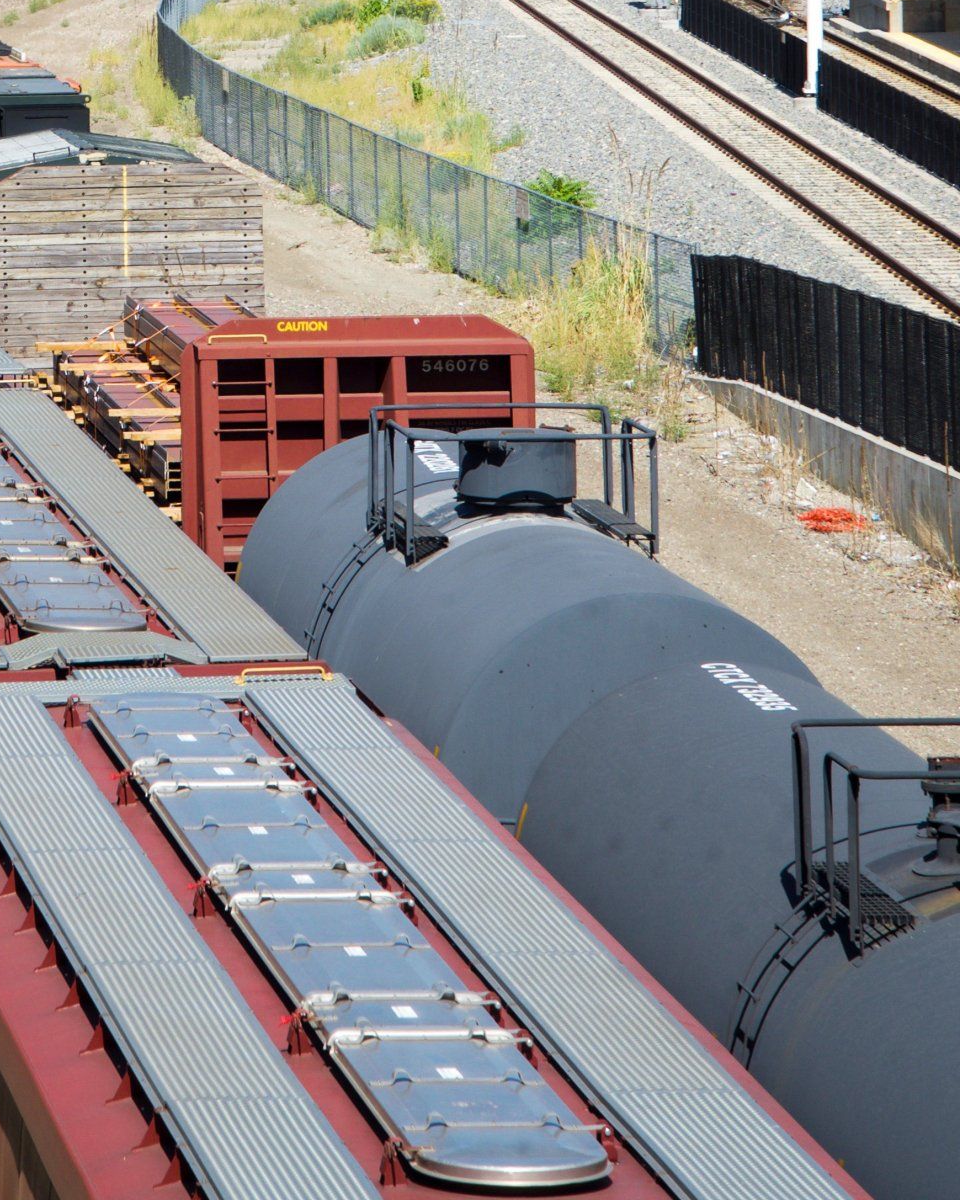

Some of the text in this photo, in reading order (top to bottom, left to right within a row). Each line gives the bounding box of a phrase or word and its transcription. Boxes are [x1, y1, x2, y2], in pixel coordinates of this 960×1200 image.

[276, 320, 328, 332] CAUTION
[422, 358, 489, 373] 546076
[700, 662, 758, 685] CTCX
